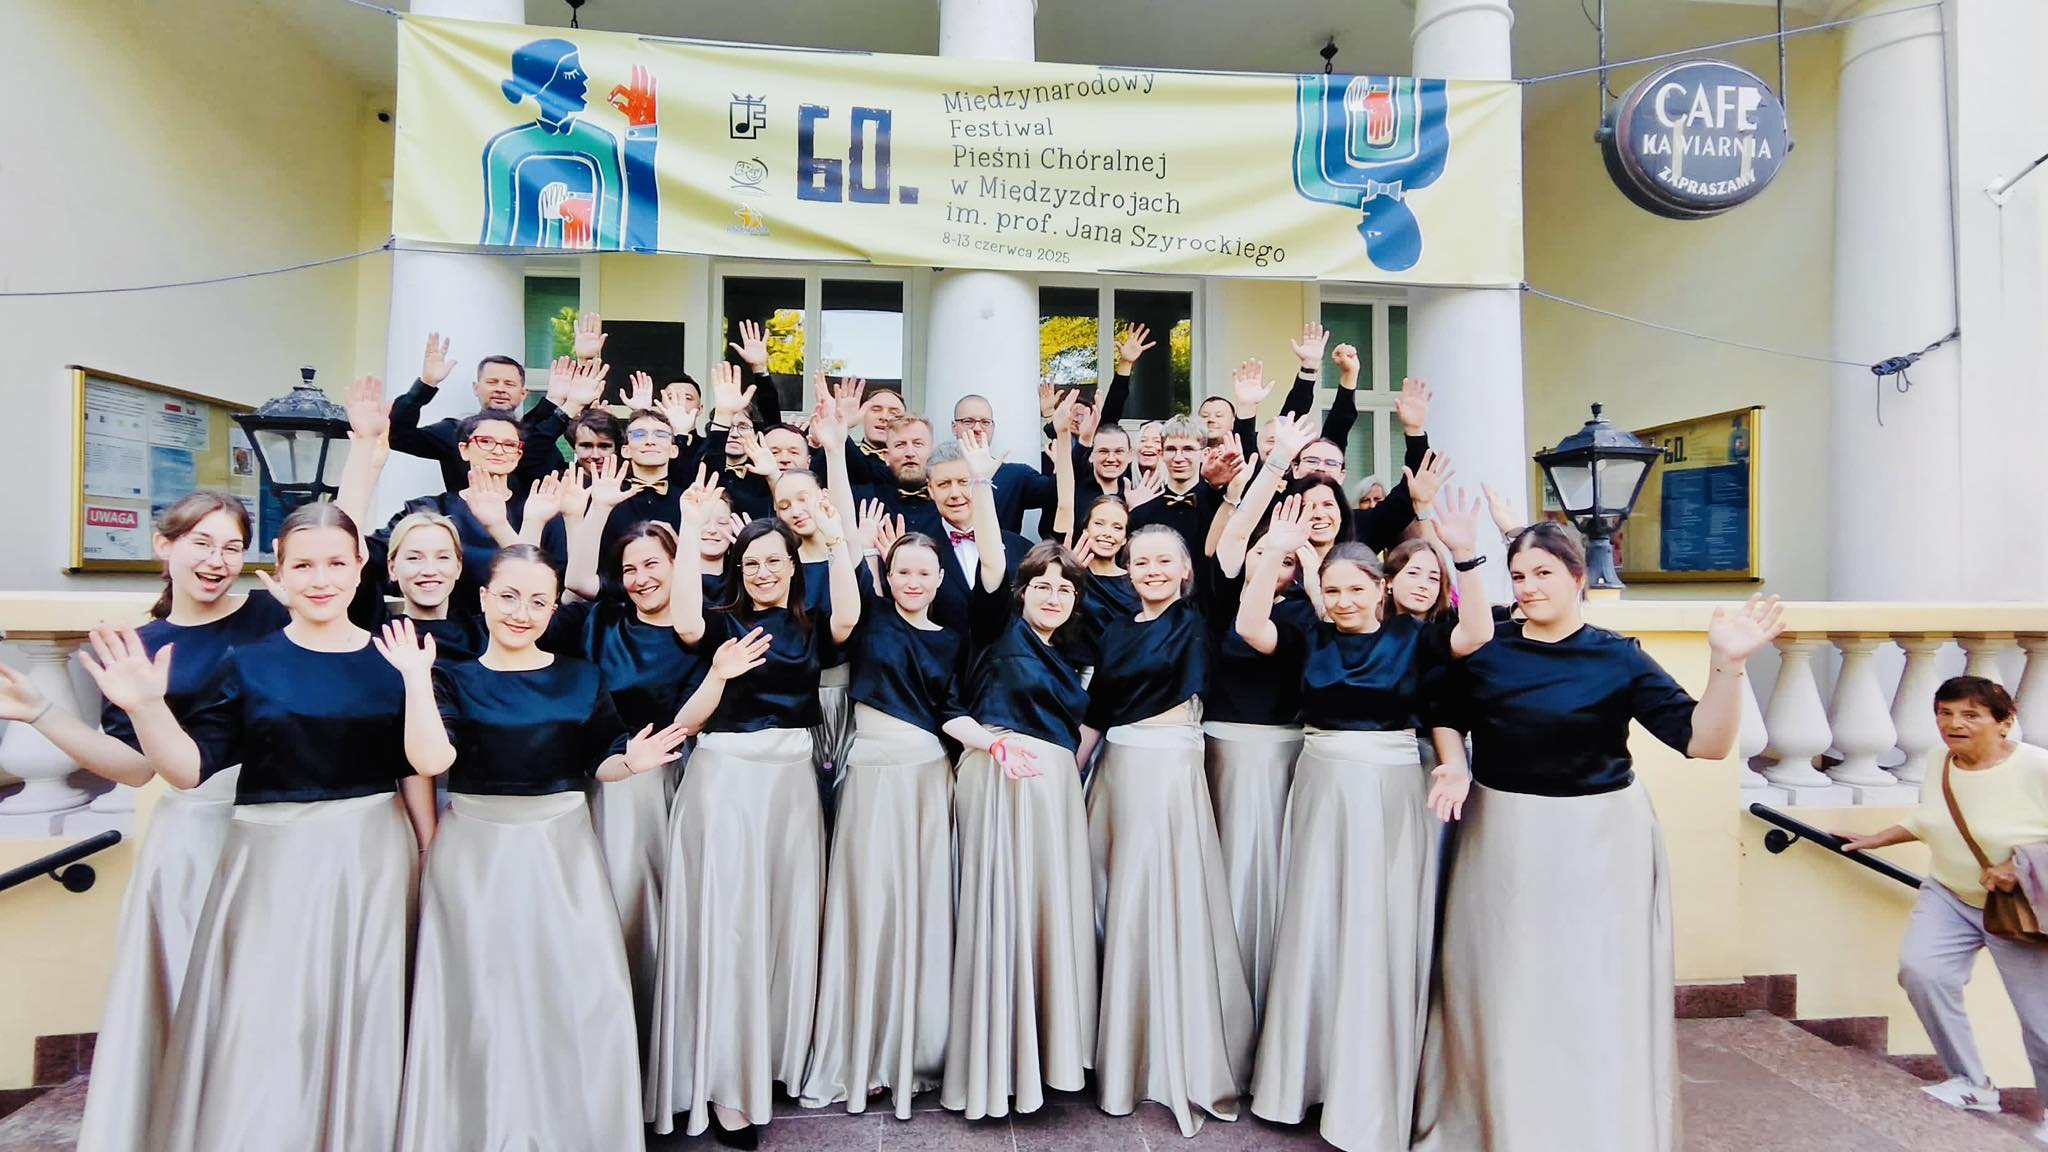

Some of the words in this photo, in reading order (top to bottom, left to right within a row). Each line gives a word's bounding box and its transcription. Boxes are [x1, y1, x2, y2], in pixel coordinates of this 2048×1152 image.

[942, 73, 1155, 114] Międzynarodowy
[950, 117, 1055, 139] Festiwal
[796, 103, 919, 205] 60.
[952, 144, 1032, 169] Pieśni
[1040, 147, 1168, 180] Chóralnej
[951, 179, 969, 196] w
[979, 175, 1181, 216] Międzyzdrojach
[942, 231, 970, 248] 8-13
[974, 238, 1033, 259] czerwca
[1036, 247, 1072, 265] 2025
[946, 201, 987, 226] im.
[996, 208, 1058, 235] prof.
[1065, 216, 1122, 245] Jana
[1130, 225, 1286, 268] Szyrockiego
[90, 510, 136, 525] UWAGA
